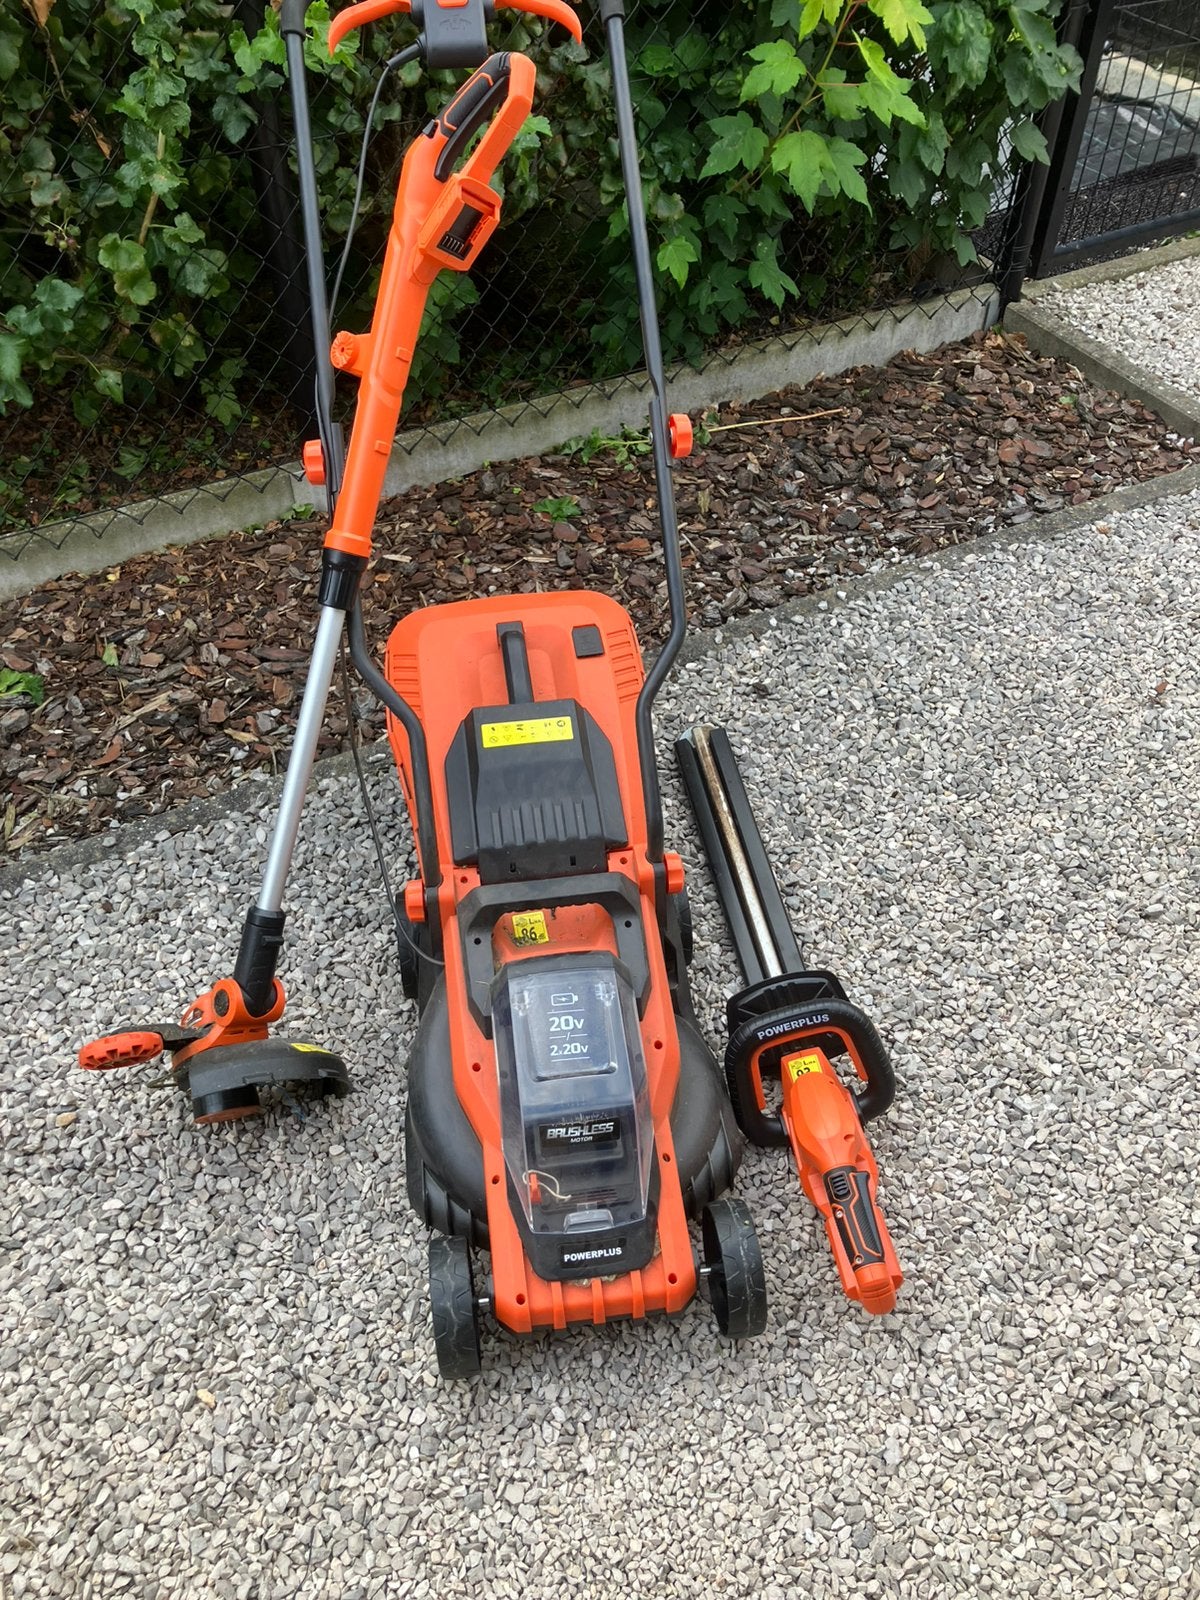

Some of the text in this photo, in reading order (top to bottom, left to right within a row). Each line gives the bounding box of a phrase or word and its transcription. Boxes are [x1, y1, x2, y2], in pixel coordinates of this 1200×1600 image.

[757, 1014, 830, 1040] POWERPLUS
[546, 1122, 614, 1139] BRUSHLESS
[564, 1247, 622, 1262] POWERPLUS
